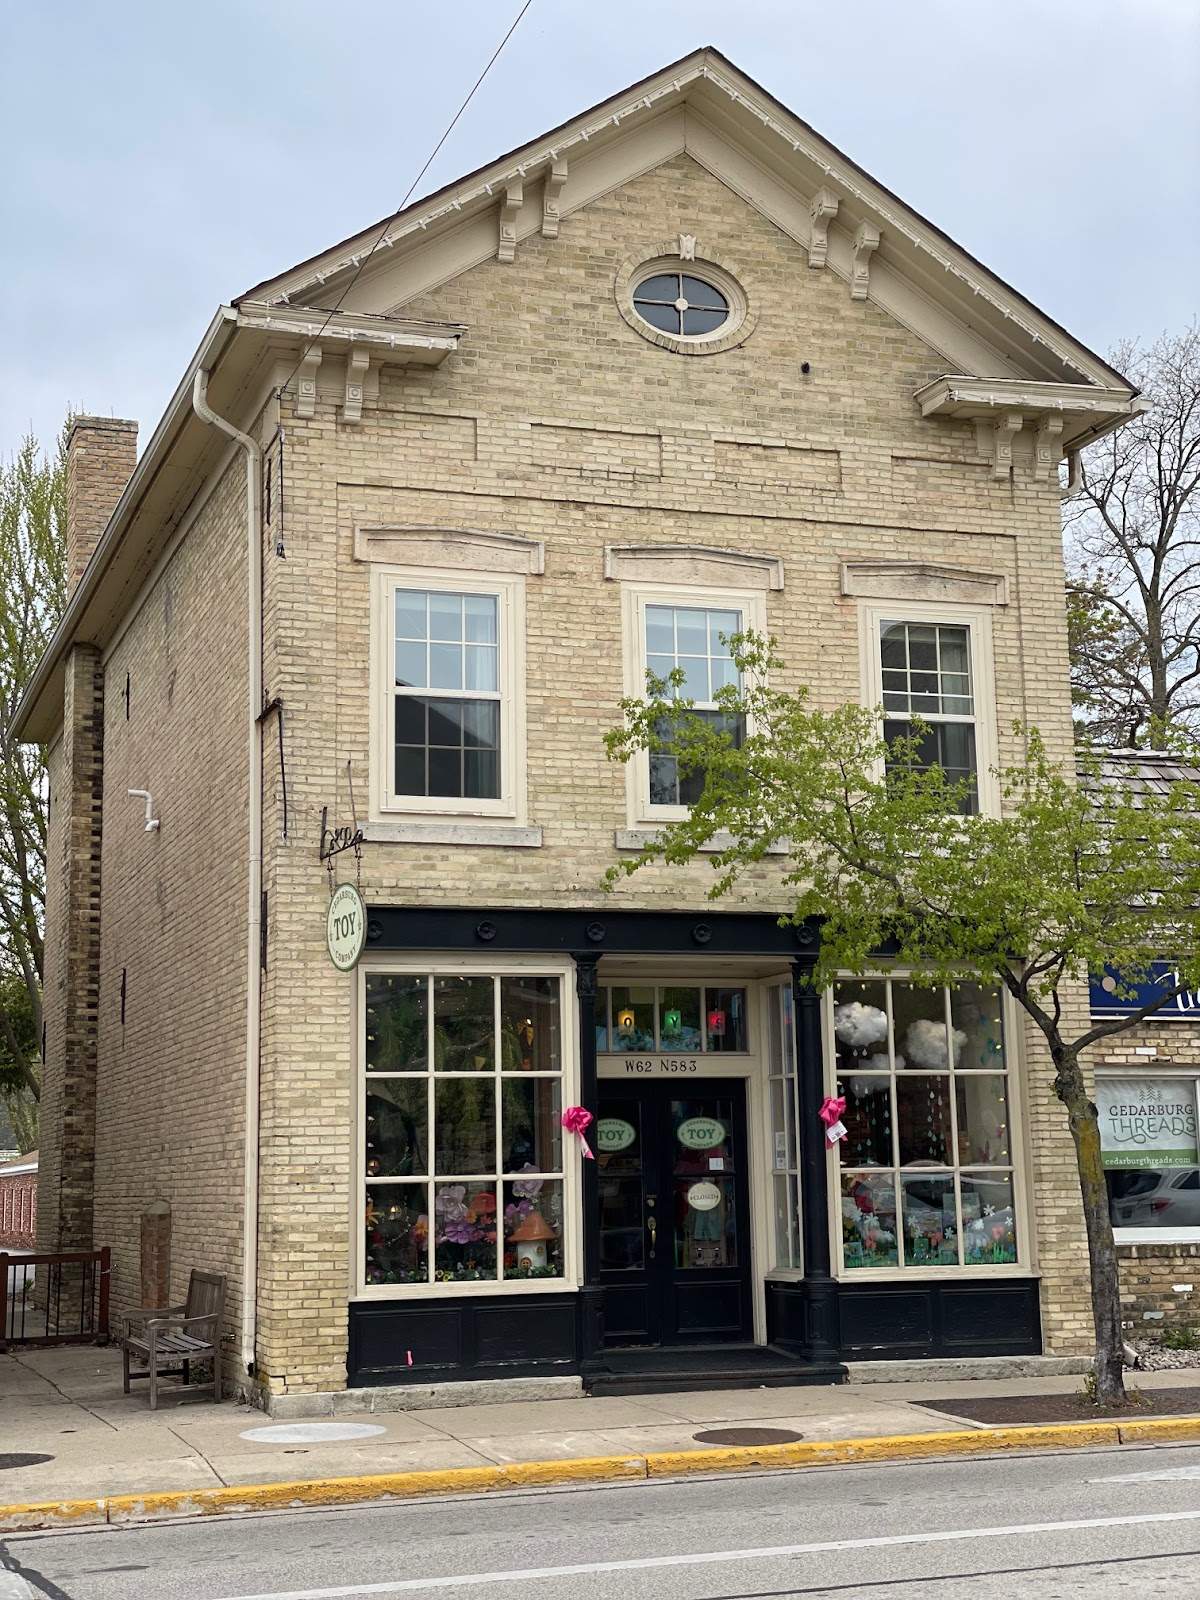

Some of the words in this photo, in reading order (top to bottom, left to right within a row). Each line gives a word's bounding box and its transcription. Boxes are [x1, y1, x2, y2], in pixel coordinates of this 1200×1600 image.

[334, 911, 356, 941] TOY
[625, 1060, 652, 1072] W62
[660, 1059, 697, 1072] N583
[1109, 1104, 1193, 1117] CEDARBURG
[598, 1130, 625, 1141] TOY
[687, 1129, 716, 1140] TOY
[1108, 1117, 1197, 1144] THREADS
[1105, 1156, 1191, 1166] cedarburgthreads.com
